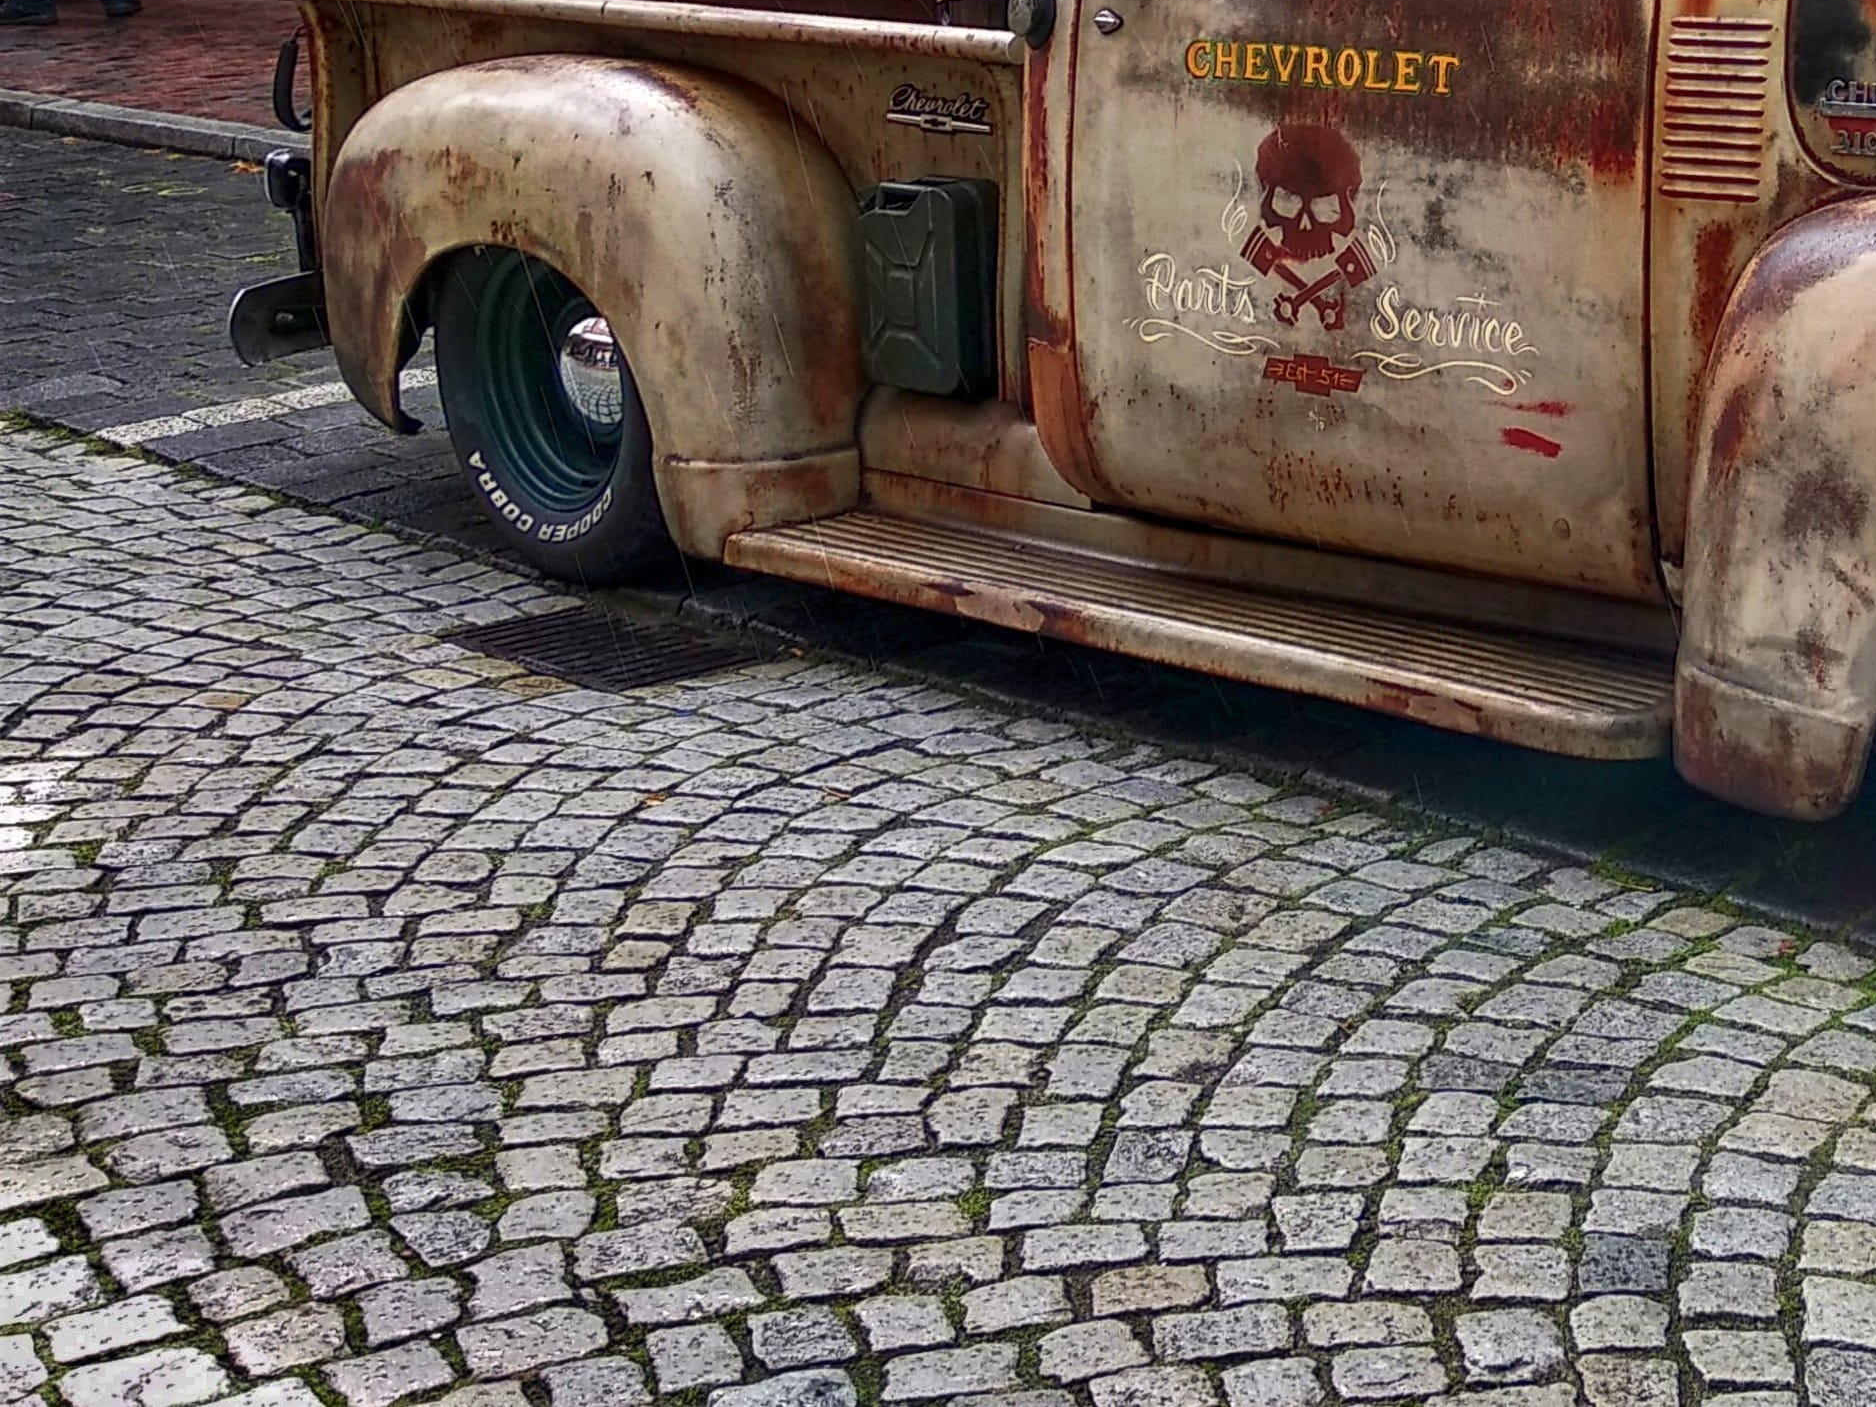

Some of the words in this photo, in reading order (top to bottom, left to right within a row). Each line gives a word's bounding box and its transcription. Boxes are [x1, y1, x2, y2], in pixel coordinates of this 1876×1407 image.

[1186, 40, 1459, 94] CHEVROLET
[889, 86, 986, 121] Chevrolet
[1139, 253, 1256, 323] Parts
[1375, 286, 1540, 356] Service
[467, 449, 534, 533] COBRA
[538, 487, 613, 544] COOPER
